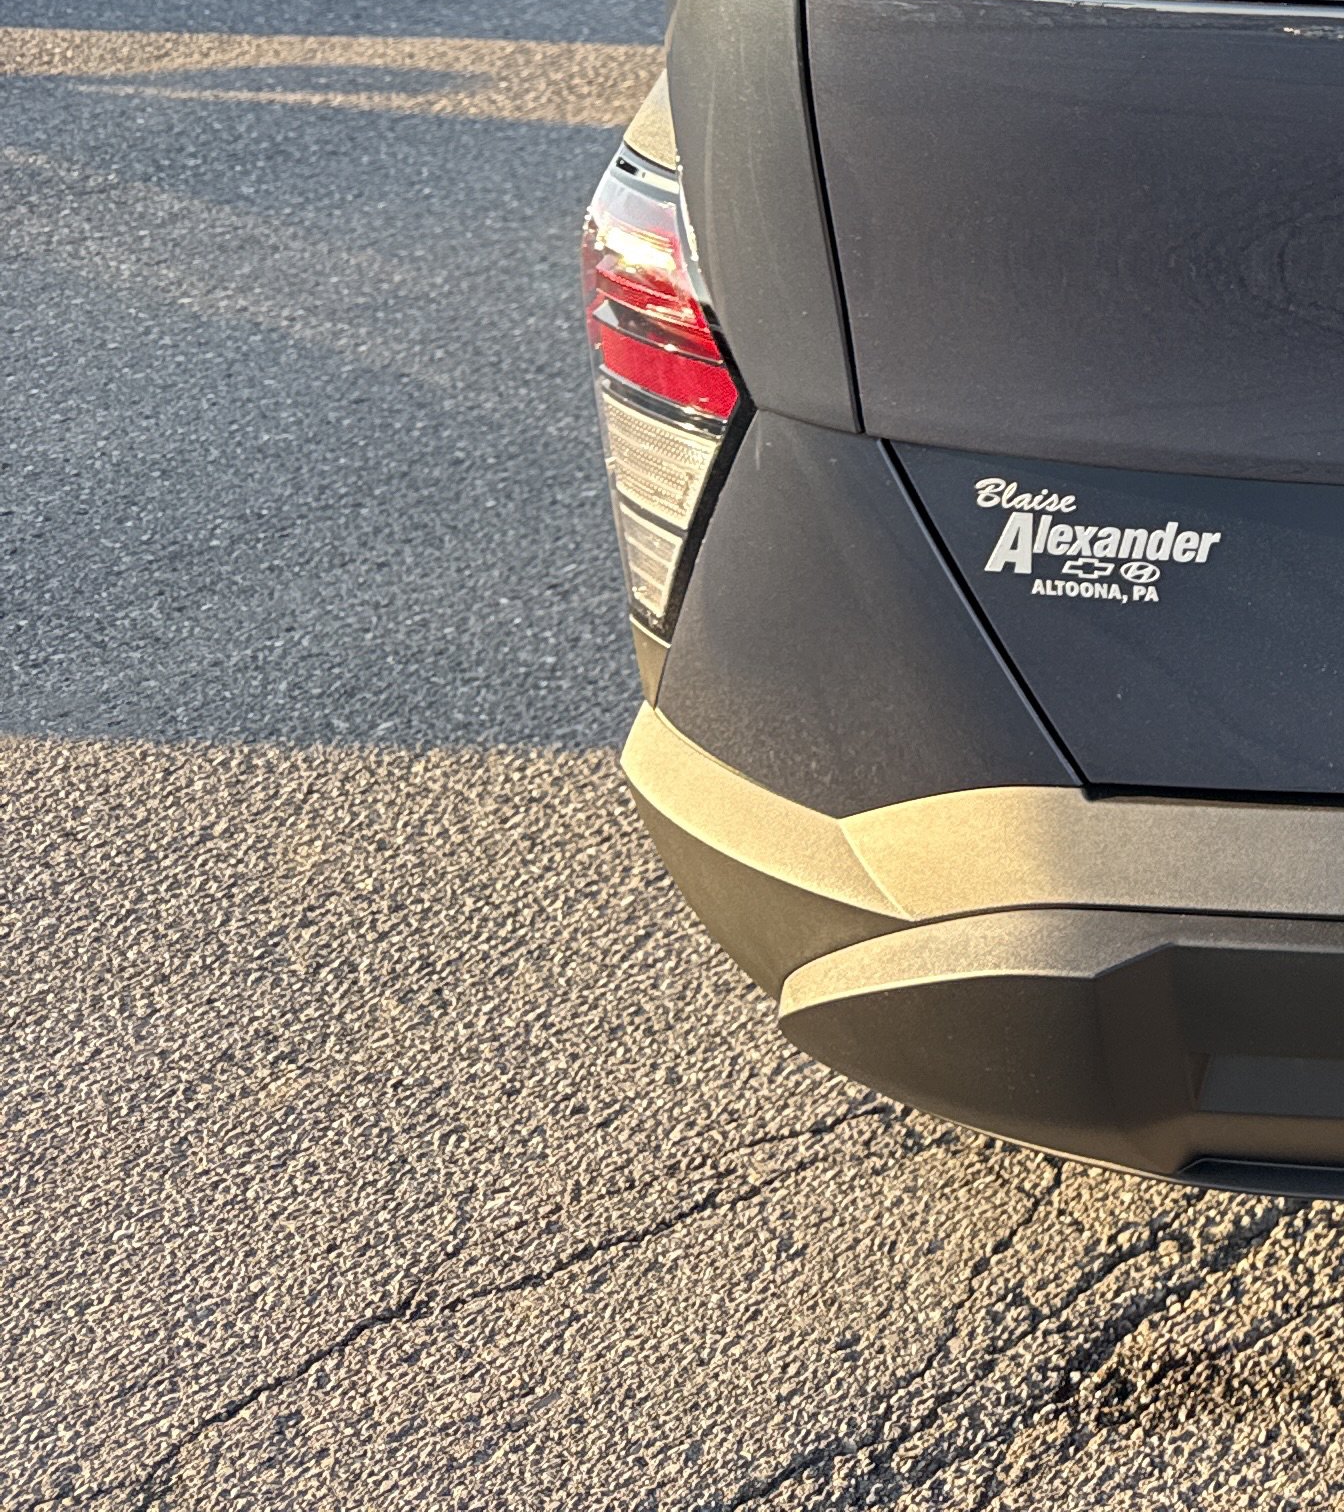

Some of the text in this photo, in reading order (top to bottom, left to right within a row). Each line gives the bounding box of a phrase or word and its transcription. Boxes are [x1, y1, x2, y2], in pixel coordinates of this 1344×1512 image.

[974, 477, 1077, 513] Blaise
[984, 511, 1222, 575] Alexander
[1031, 578, 1160, 604] ALTOONA, PA
